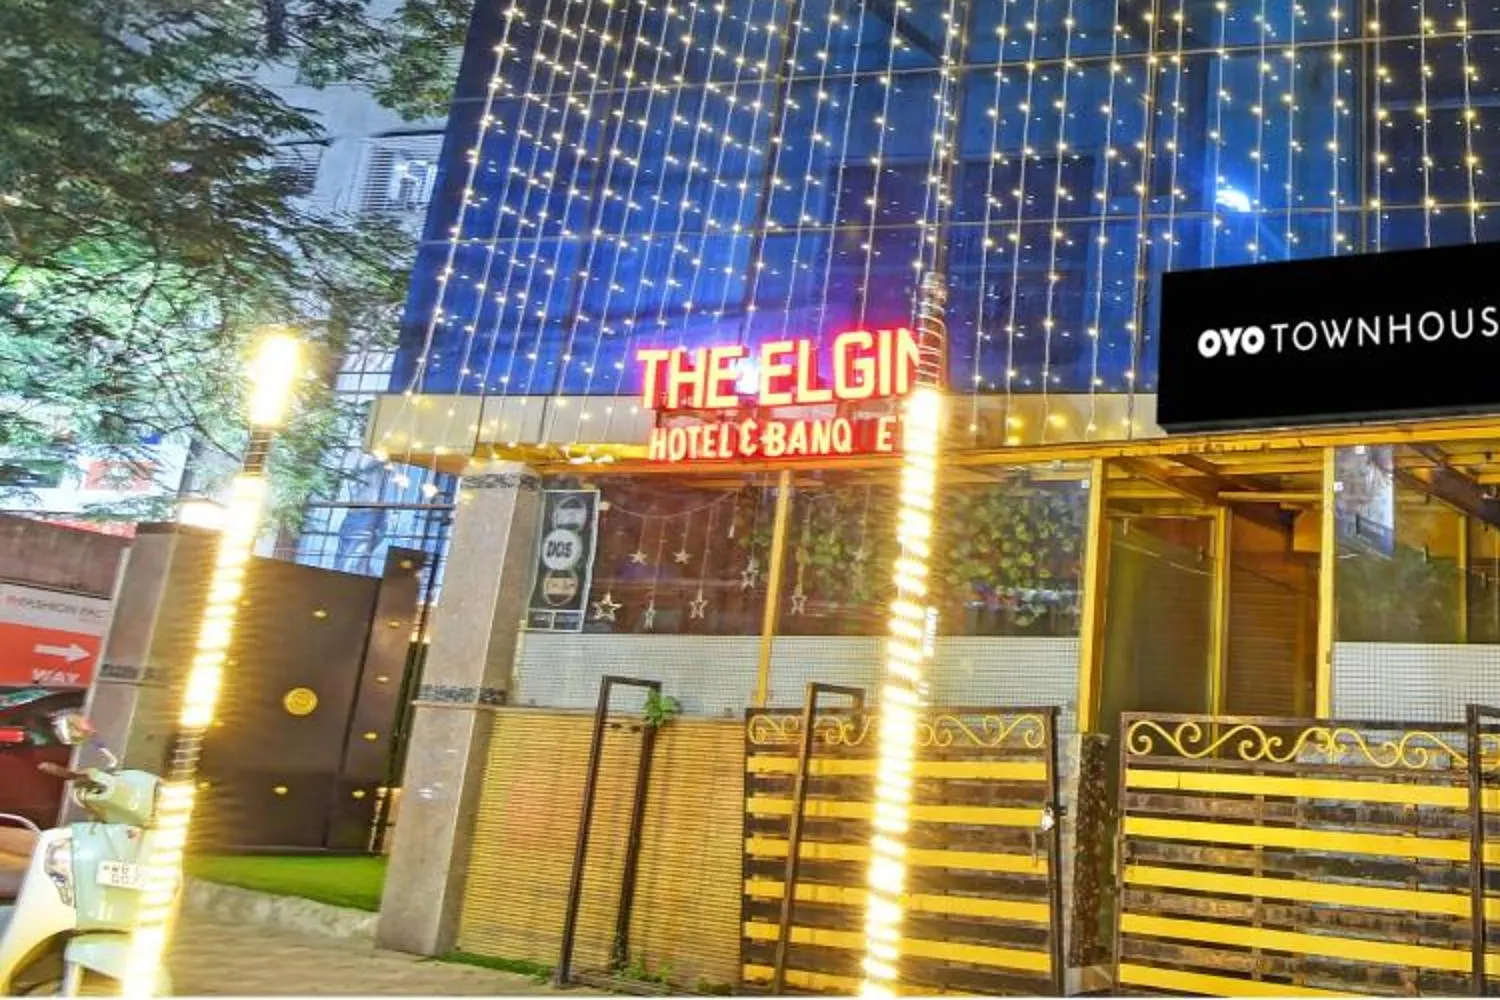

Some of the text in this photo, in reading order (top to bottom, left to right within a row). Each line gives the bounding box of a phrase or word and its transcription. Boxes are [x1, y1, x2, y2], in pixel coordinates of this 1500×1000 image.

[1197, 325, 1266, 359] OYO
[636, 327, 920, 410] THE ELGIN
[648, 423, 733, 462] HOTEL
[761, 414, 906, 458] BANQE
[546, 540, 573, 558] DOS
[32, 667, 81, 686] WAY
